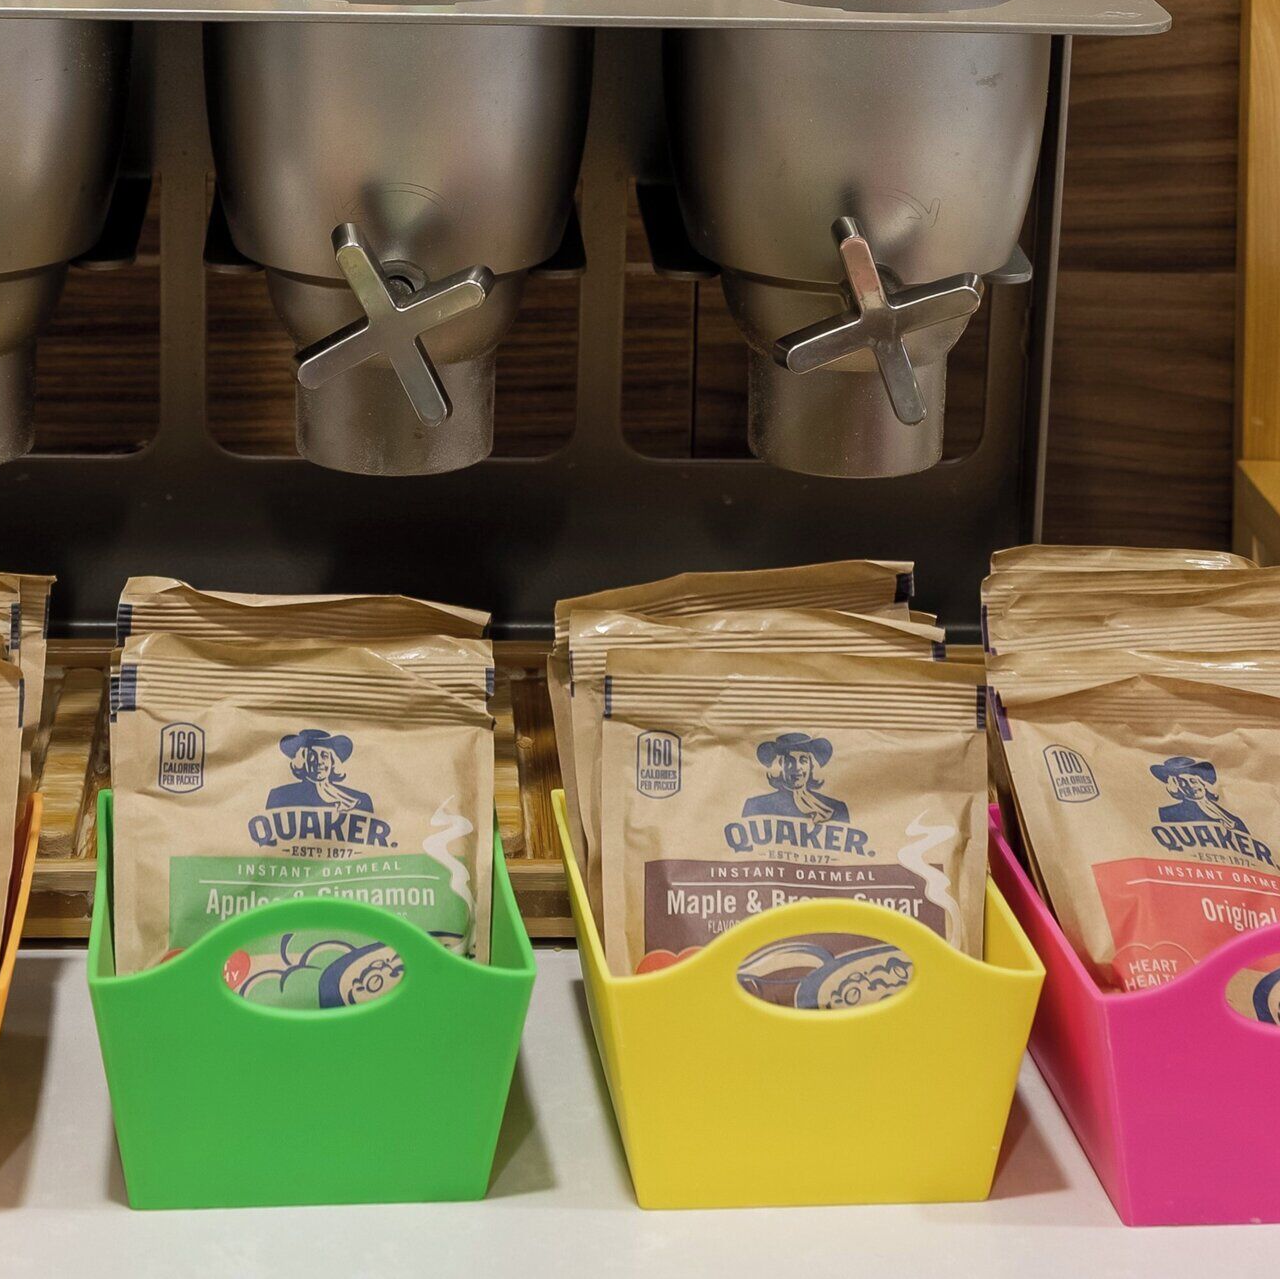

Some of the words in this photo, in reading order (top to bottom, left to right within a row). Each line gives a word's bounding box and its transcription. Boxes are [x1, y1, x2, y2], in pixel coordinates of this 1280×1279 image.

[168, 730, 196, 761] 160
[645, 738, 672, 767] 160
[163, 761, 200, 774] CALORIES
[1051, 750, 1083, 774] 100
[247, 811, 391, 848] QUAKER
[723, 819, 869, 857] QUAKER
[326, 848, 353, 859] 1877
[1150, 825, 1275, 871] QUAKER
[237, 864, 312, 878] INSTANT
[322, 861, 402, 878] OATMEAL
[803, 854, 831, 864] 1877
[709, 867, 786, 879] INSTANT
[795, 869, 876, 882] OATMEAL
[1157, 865, 1224, 881] INSTANT
[666, 888, 737, 919] Maple
[746, 889, 763, 914] &
[1200, 897, 1278, 932] Original
[1128, 958, 1178, 975] HEART
[1124, 973, 1176, 992] HEALT
